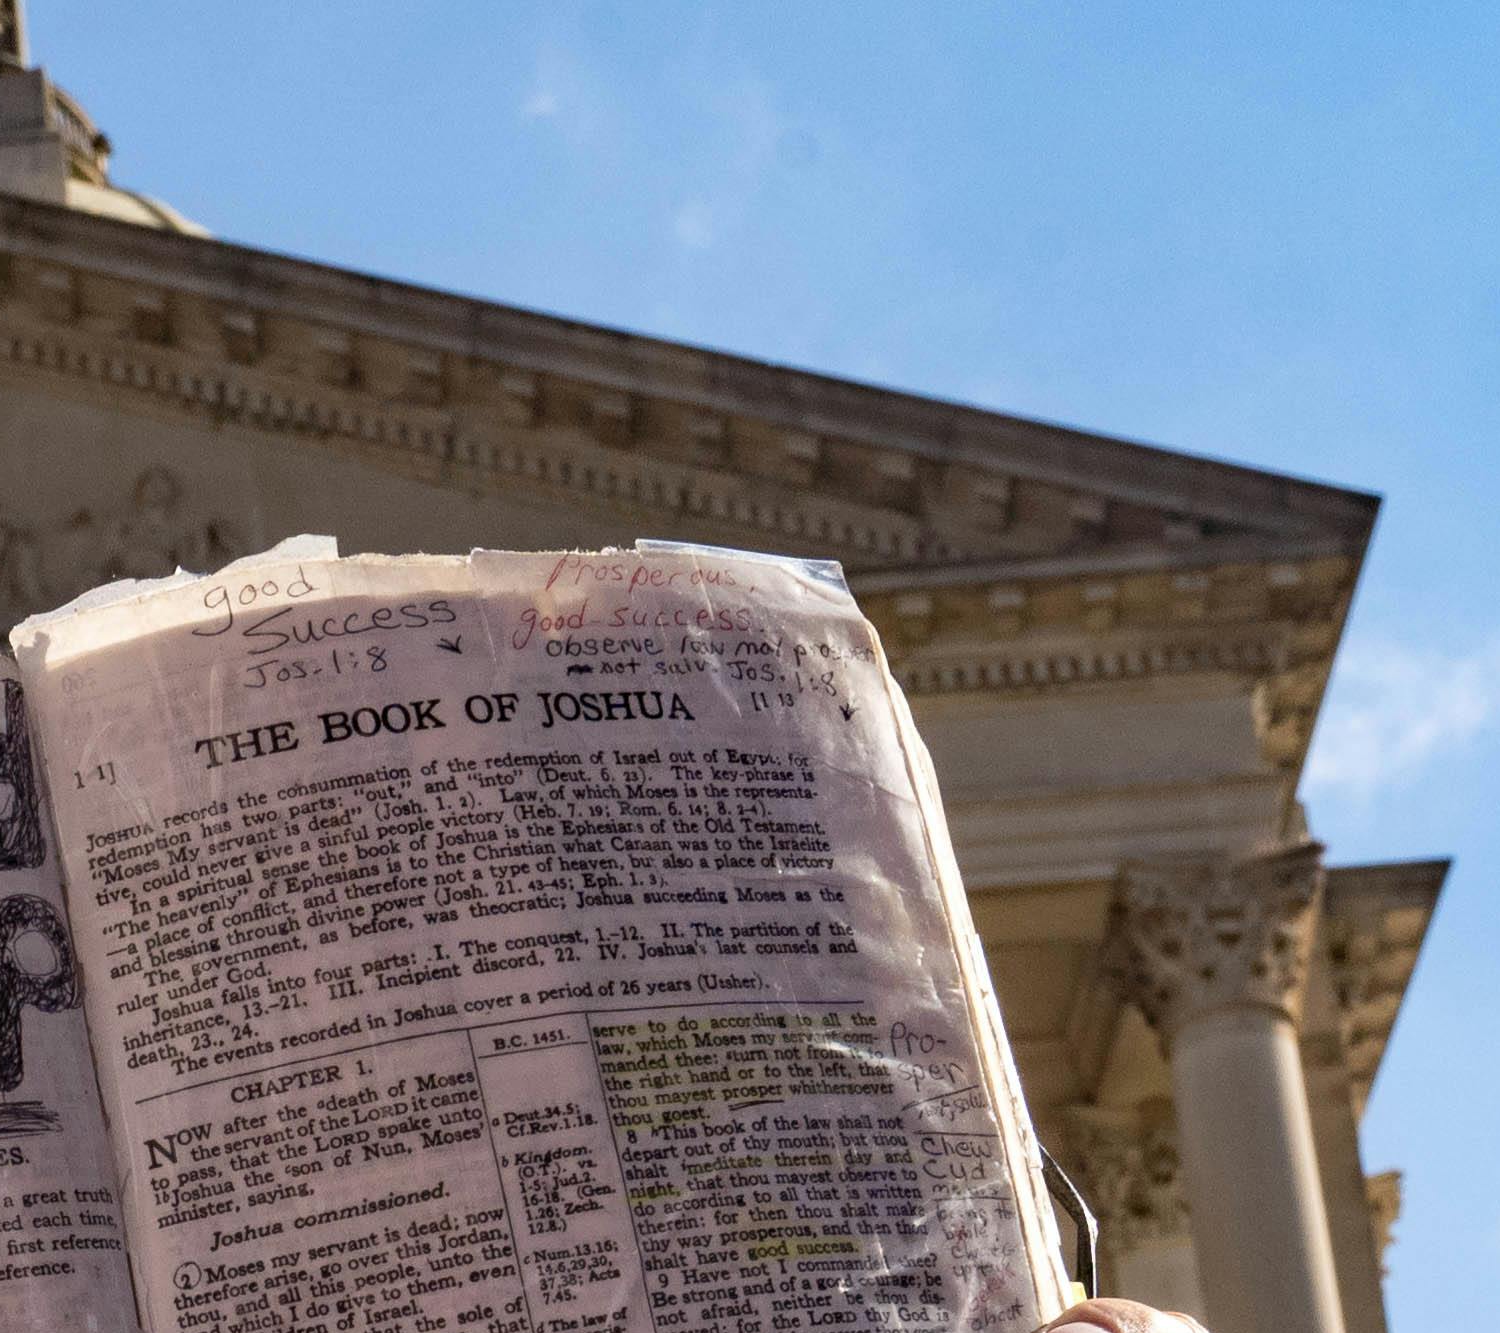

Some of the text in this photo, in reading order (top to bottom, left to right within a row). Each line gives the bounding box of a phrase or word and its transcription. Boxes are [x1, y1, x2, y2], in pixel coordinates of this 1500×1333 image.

[192, 564, 320, 637] good
[243, 600, 457, 655] Success
[194, 690, 696, 770] THE BOOK OF JOSHUA
[170, 1055, 209, 1076] The
[213, 1041, 275, 1065] events
[279, 1017, 363, 1050] recorded
[366, 1013, 387, 1030] in
[393, 1003, 458, 1027] Joshua
[463, 995, 514, 1013] cover
[519, 993, 532, 1005] a
[537, 981, 594, 1004] period
[597, 980, 615, 997] of
[620, 979, 641, 996] 26
[645, 980, 692, 996] years
[230, 1060, 373, 1104] CHAPTER 1.
[3, 1196, 15, 1208] a
[22, 1190, 67, 1208] great
[74, 1188, 113, 1204] truth
[32, 1211, 73, 1229] each
[212, 1184, 450, 1251] Joshua commissioned.
